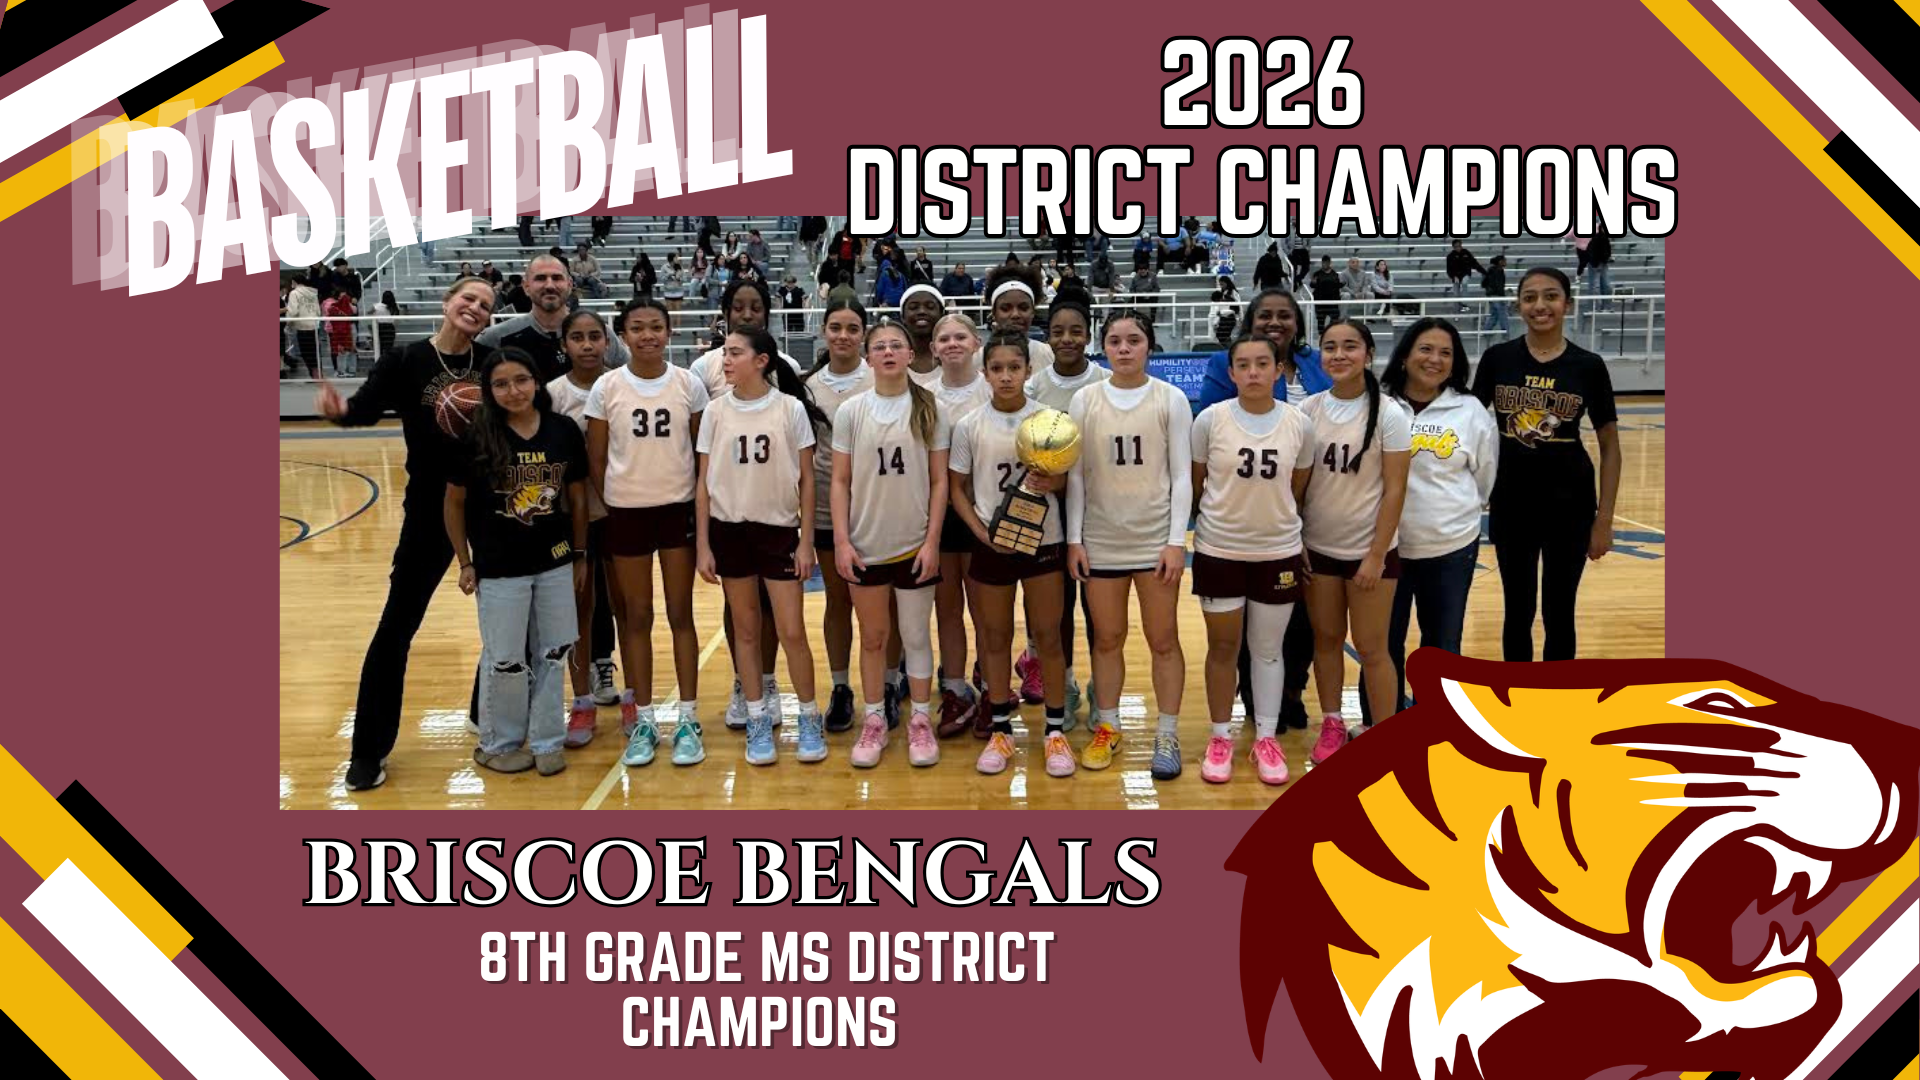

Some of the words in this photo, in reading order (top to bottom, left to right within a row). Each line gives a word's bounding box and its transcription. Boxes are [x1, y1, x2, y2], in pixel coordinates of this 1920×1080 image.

[1165, 374, 1206, 383] TEAM
[1525, 375, 1556, 389] TEAM
[1495, 384, 1583, 418] BRISCOE
[632, 408, 670, 437] 32
[1410, 423, 1443, 434] ISCOE
[517, 452, 546, 464] TEAM
[738, 434, 770, 464] 13
[878, 446, 905, 475] 14
[1115, 435, 1143, 465] 11
[1237, 447, 1279, 480] 35
[1323, 442, 1350, 474] 41
[506, 461, 567, 487] RISCO
